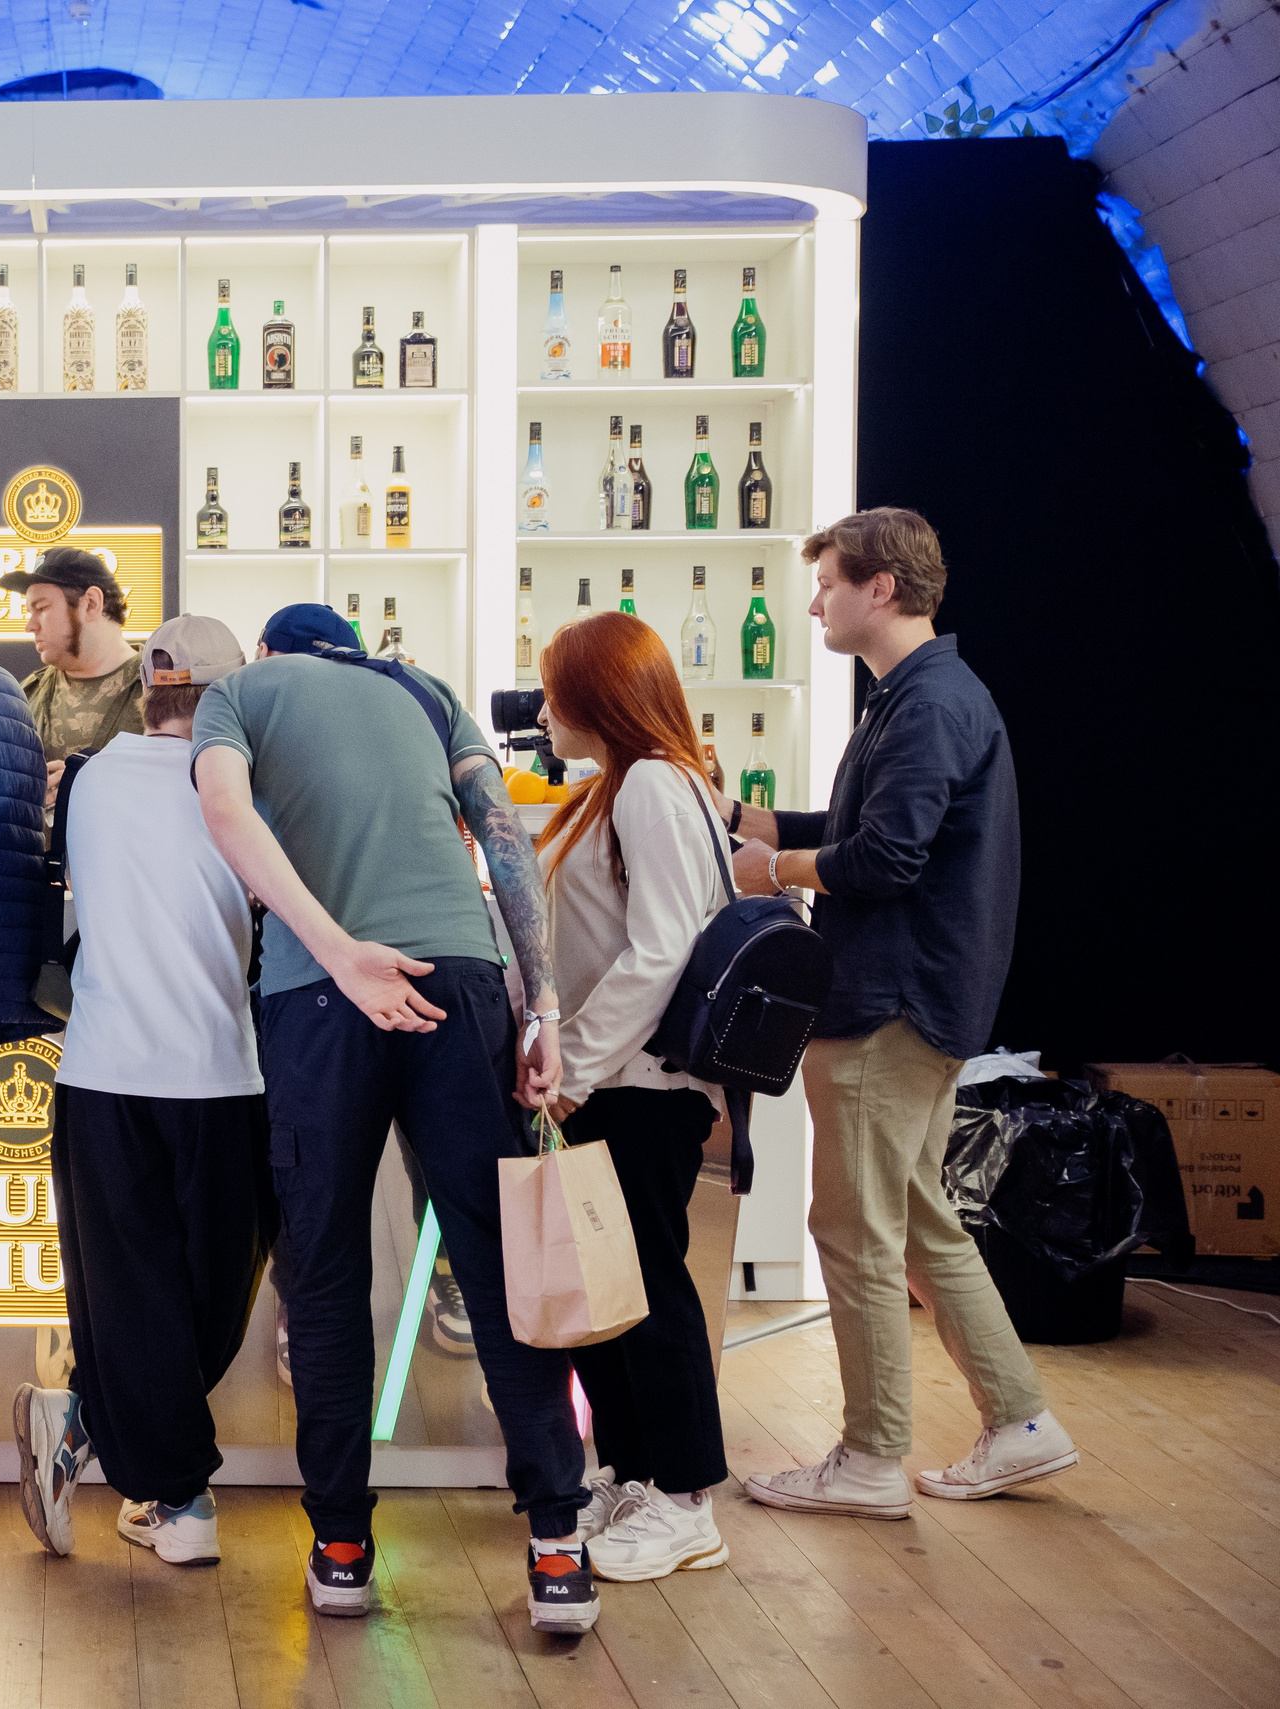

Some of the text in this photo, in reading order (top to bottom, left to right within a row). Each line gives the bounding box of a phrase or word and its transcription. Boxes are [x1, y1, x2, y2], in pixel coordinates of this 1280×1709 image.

[18, 1040, 61, 1067] SCHUL
[332, 1571, 354, 1580] FILA
[545, 1585, 569, 1594] FILA
